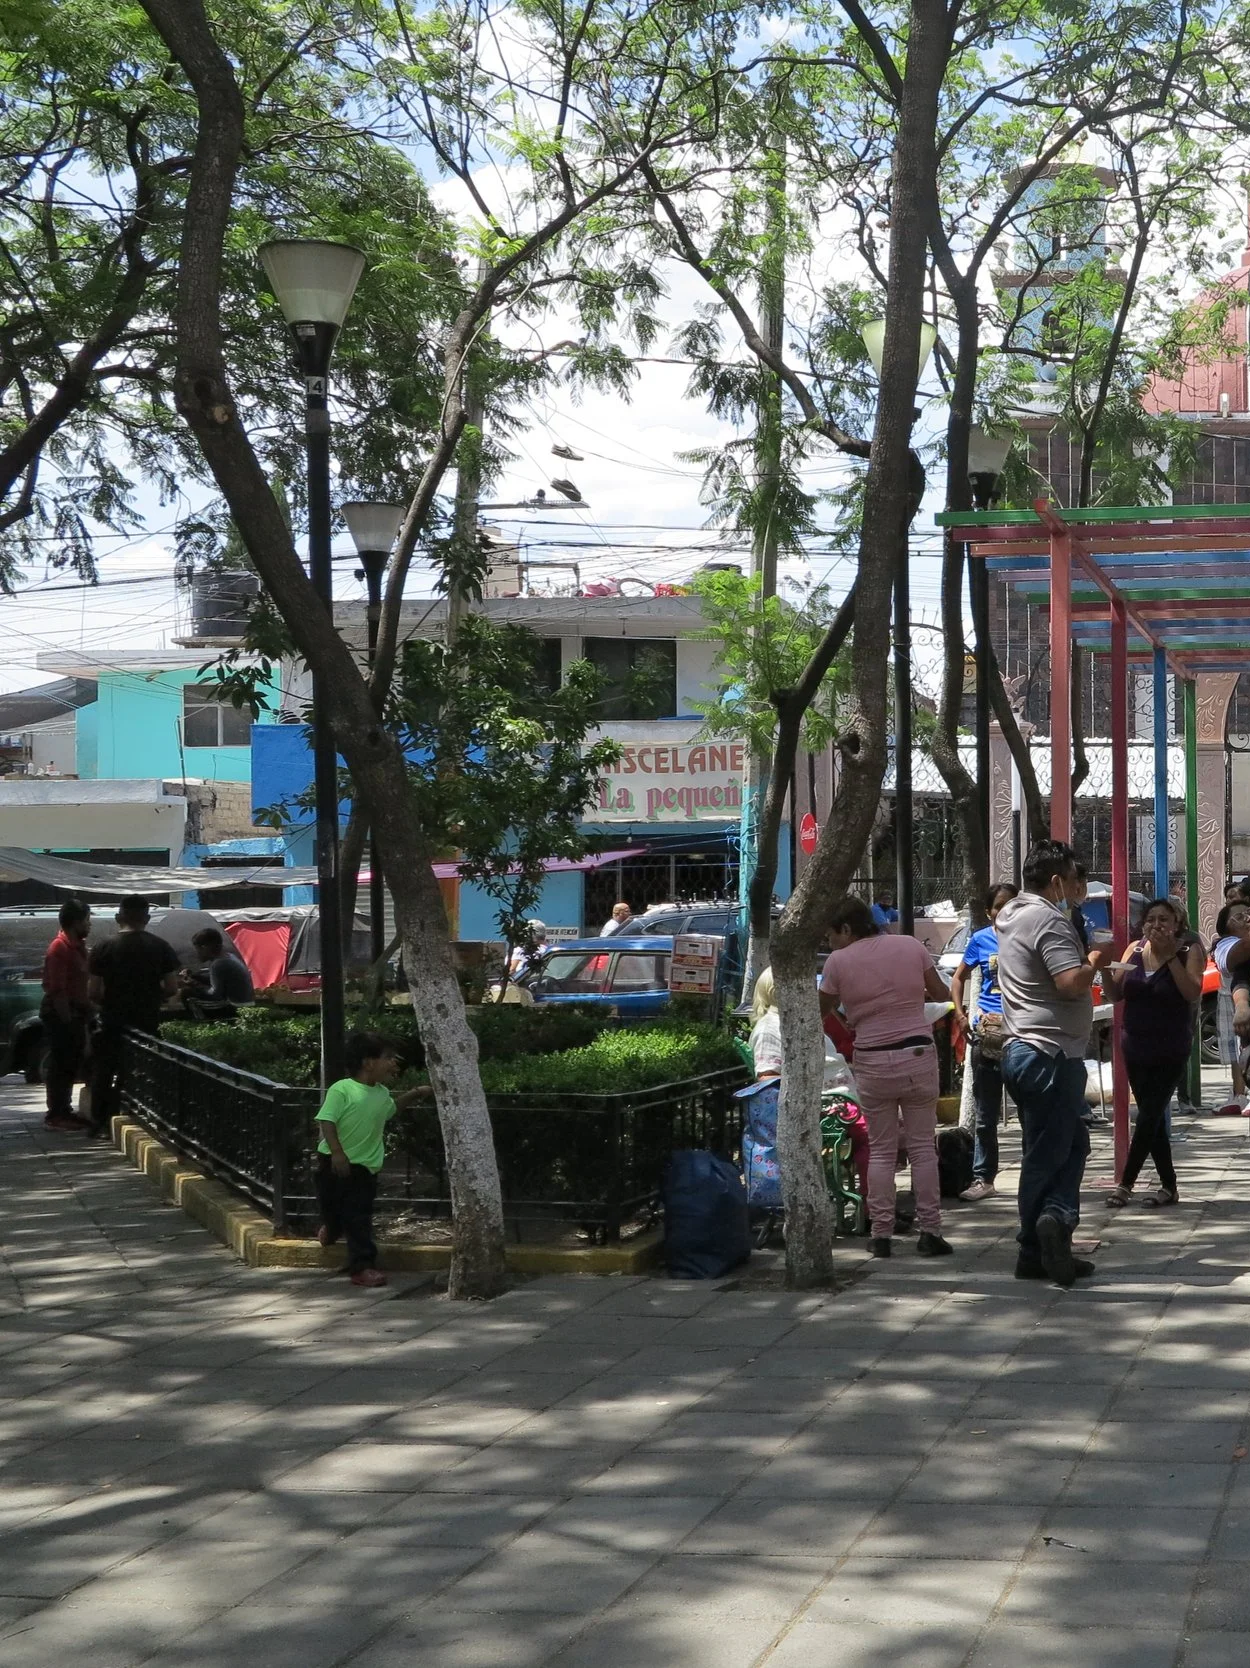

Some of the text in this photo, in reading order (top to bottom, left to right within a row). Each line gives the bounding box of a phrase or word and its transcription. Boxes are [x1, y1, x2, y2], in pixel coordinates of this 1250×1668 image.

[306, 381, 322, 393] 14
[602, 745, 744, 775] ISCELANE
[646, 777, 743, 821] pequeñ
